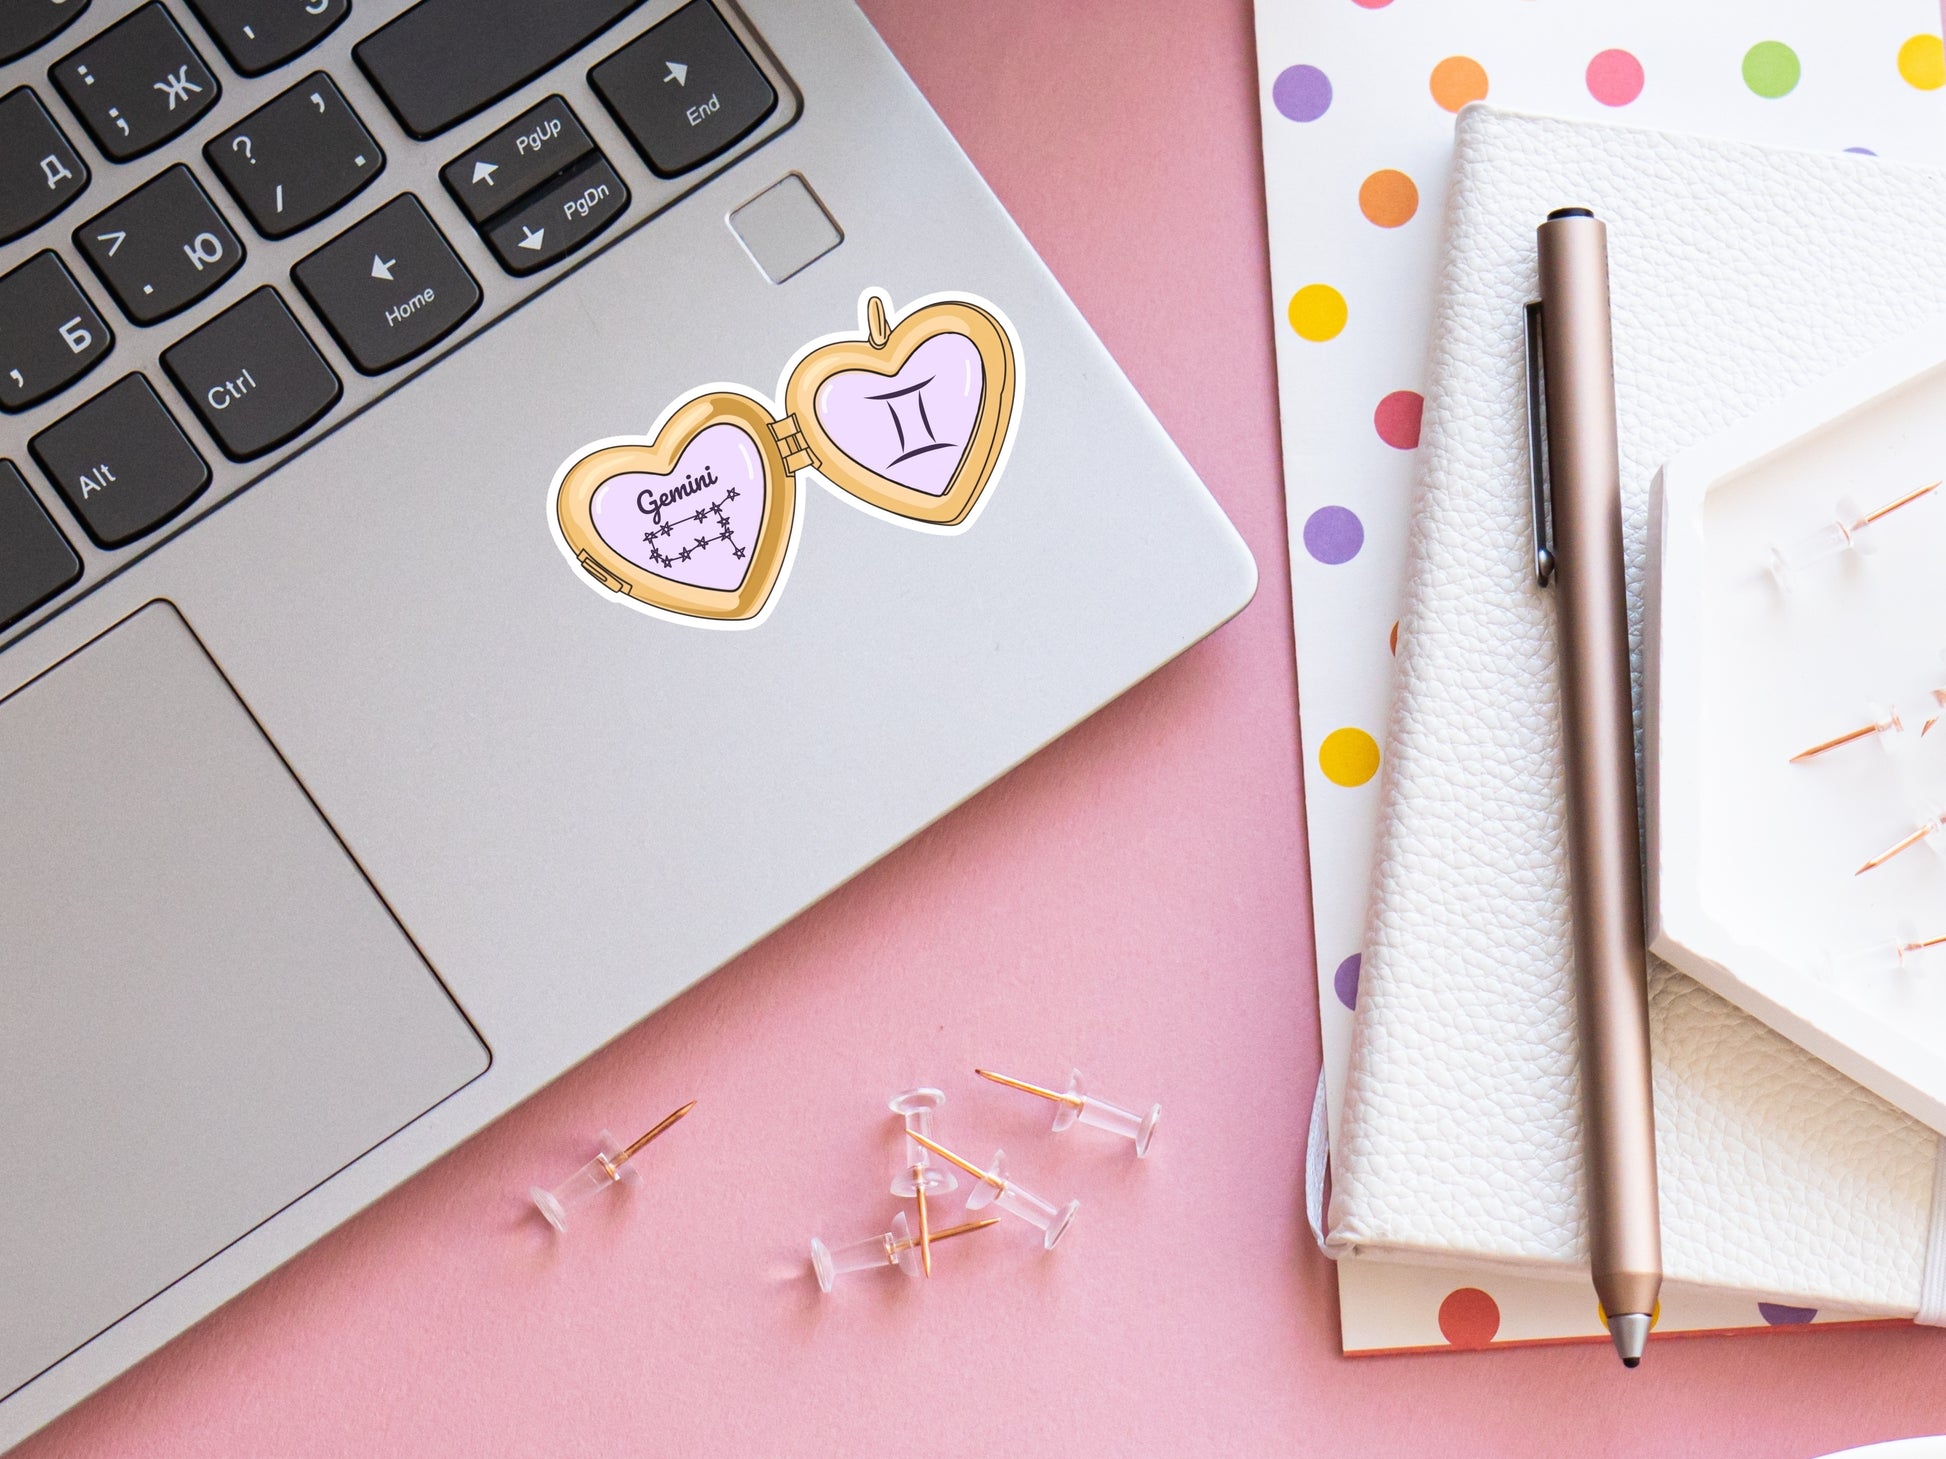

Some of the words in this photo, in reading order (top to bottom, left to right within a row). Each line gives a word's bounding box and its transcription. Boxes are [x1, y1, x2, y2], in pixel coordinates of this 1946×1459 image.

[153, 64, 202, 111] Ж
[686, 93, 721, 127] End
[232, 135, 256, 165] ?
[515, 116, 562, 155] PgUp
[40, 154, 73, 190] Д
[563, 183, 609, 220] PgDn
[183, 232, 223, 271] Ю
[385, 287, 435, 327] Home
[58, 316, 93, 354] Б
[207, 368, 257, 410] Ctrl
[78, 464, 117, 500] Alt
[636, 465, 718, 525] Gemini
